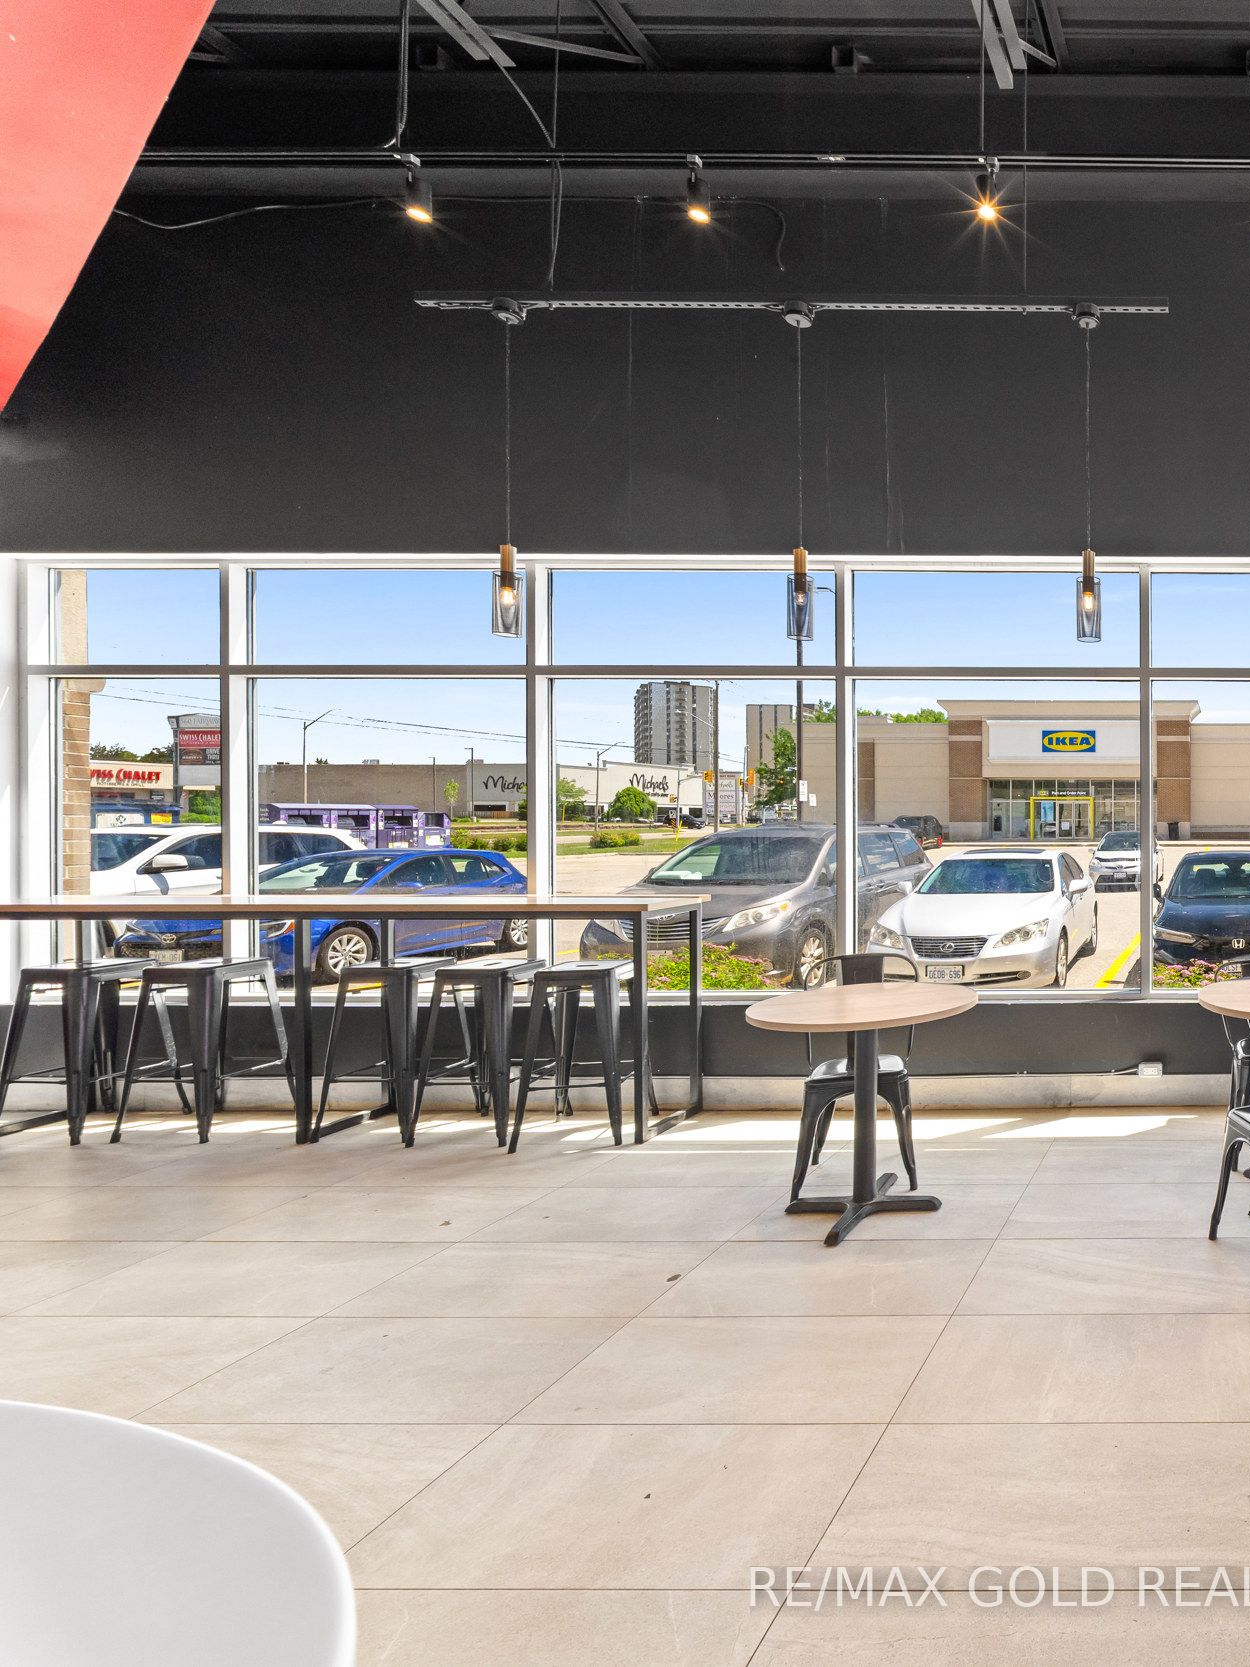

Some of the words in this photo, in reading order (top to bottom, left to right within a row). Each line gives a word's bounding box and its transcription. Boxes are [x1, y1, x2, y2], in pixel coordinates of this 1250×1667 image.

[179, 733, 199, 742] SWISS
[1047, 736, 1092, 746] IKEA
[116, 769, 162, 782] CHALET
[483, 776, 527, 792] Micha
[629, 773, 669, 792] Michaels
